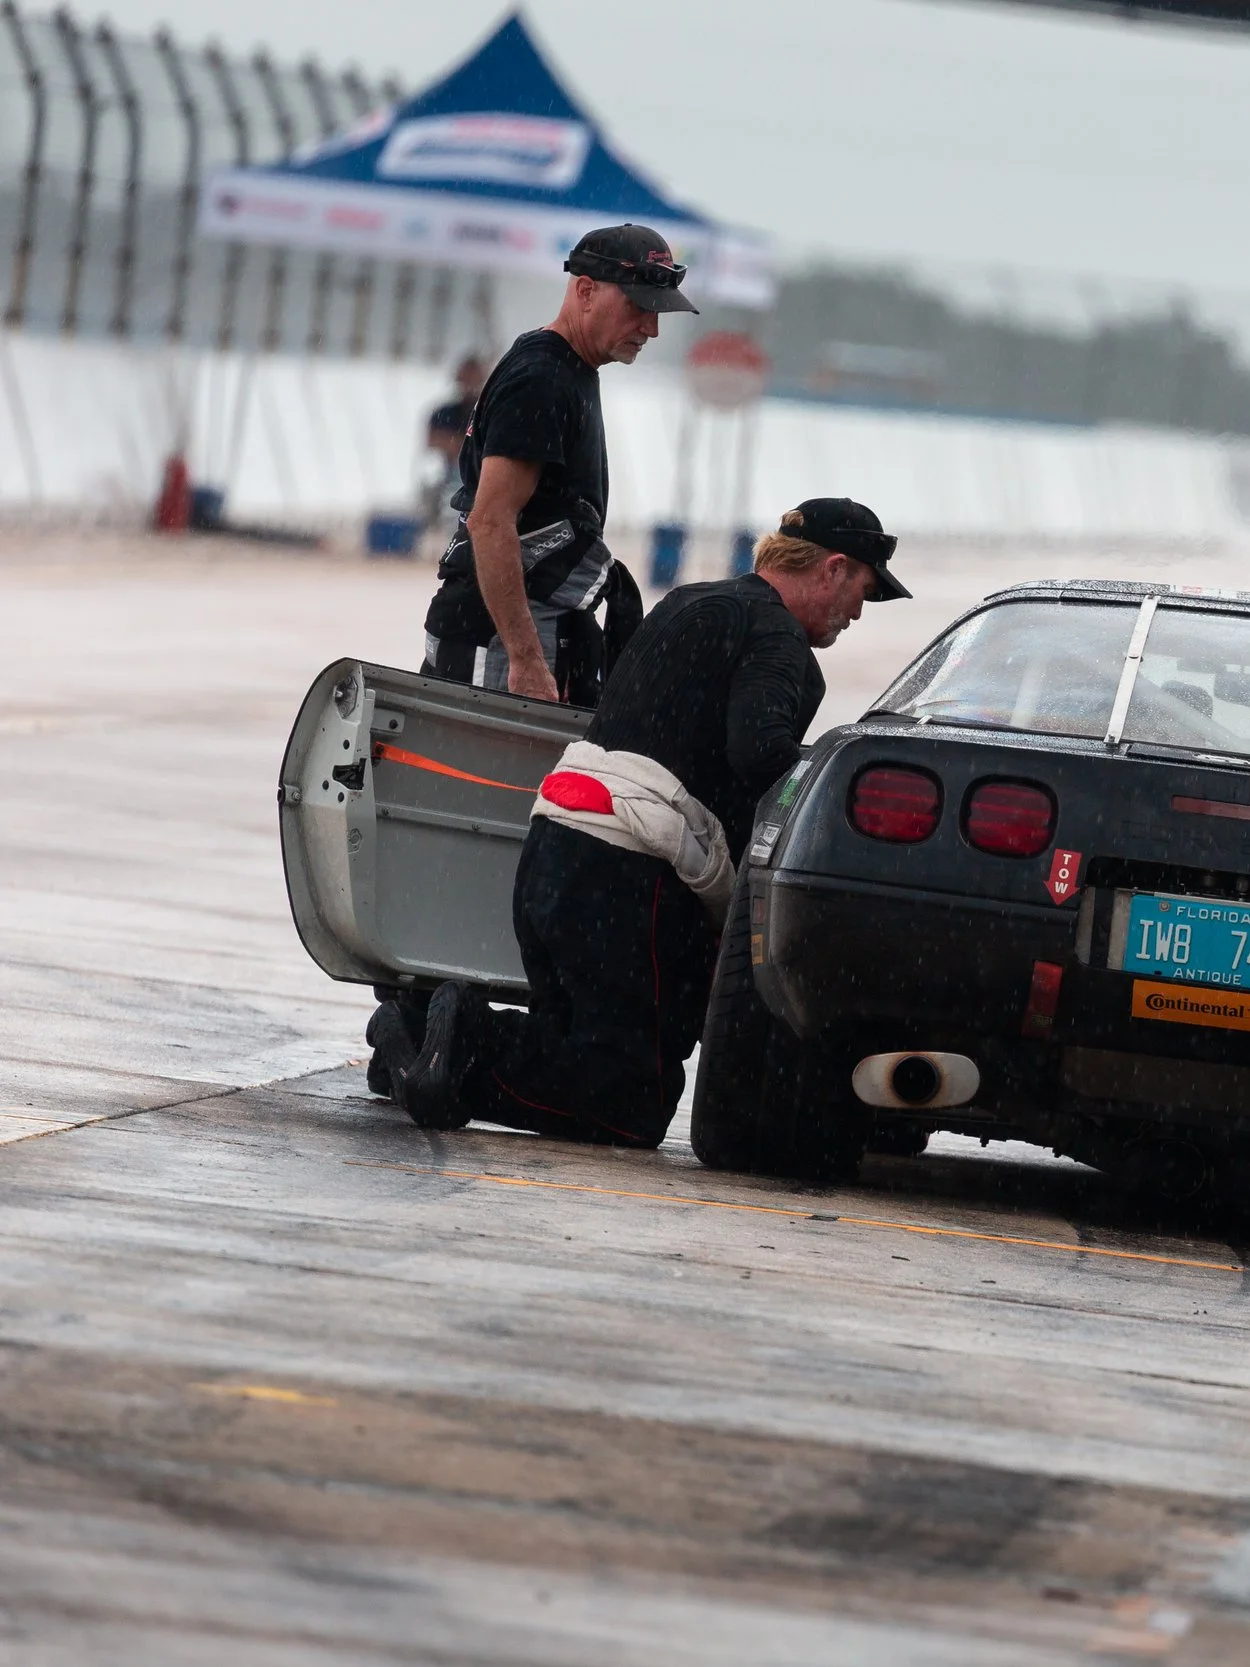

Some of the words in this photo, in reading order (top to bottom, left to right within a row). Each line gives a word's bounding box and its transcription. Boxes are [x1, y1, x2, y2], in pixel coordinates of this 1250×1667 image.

[1054, 853, 1072, 895] TOW
[1176, 906, 1250, 924] FLORIDA
[1135, 919, 1192, 964] IW8
[1173, 967, 1242, 985] ANTIQUE
[1145, 993, 1244, 1018] Continental
